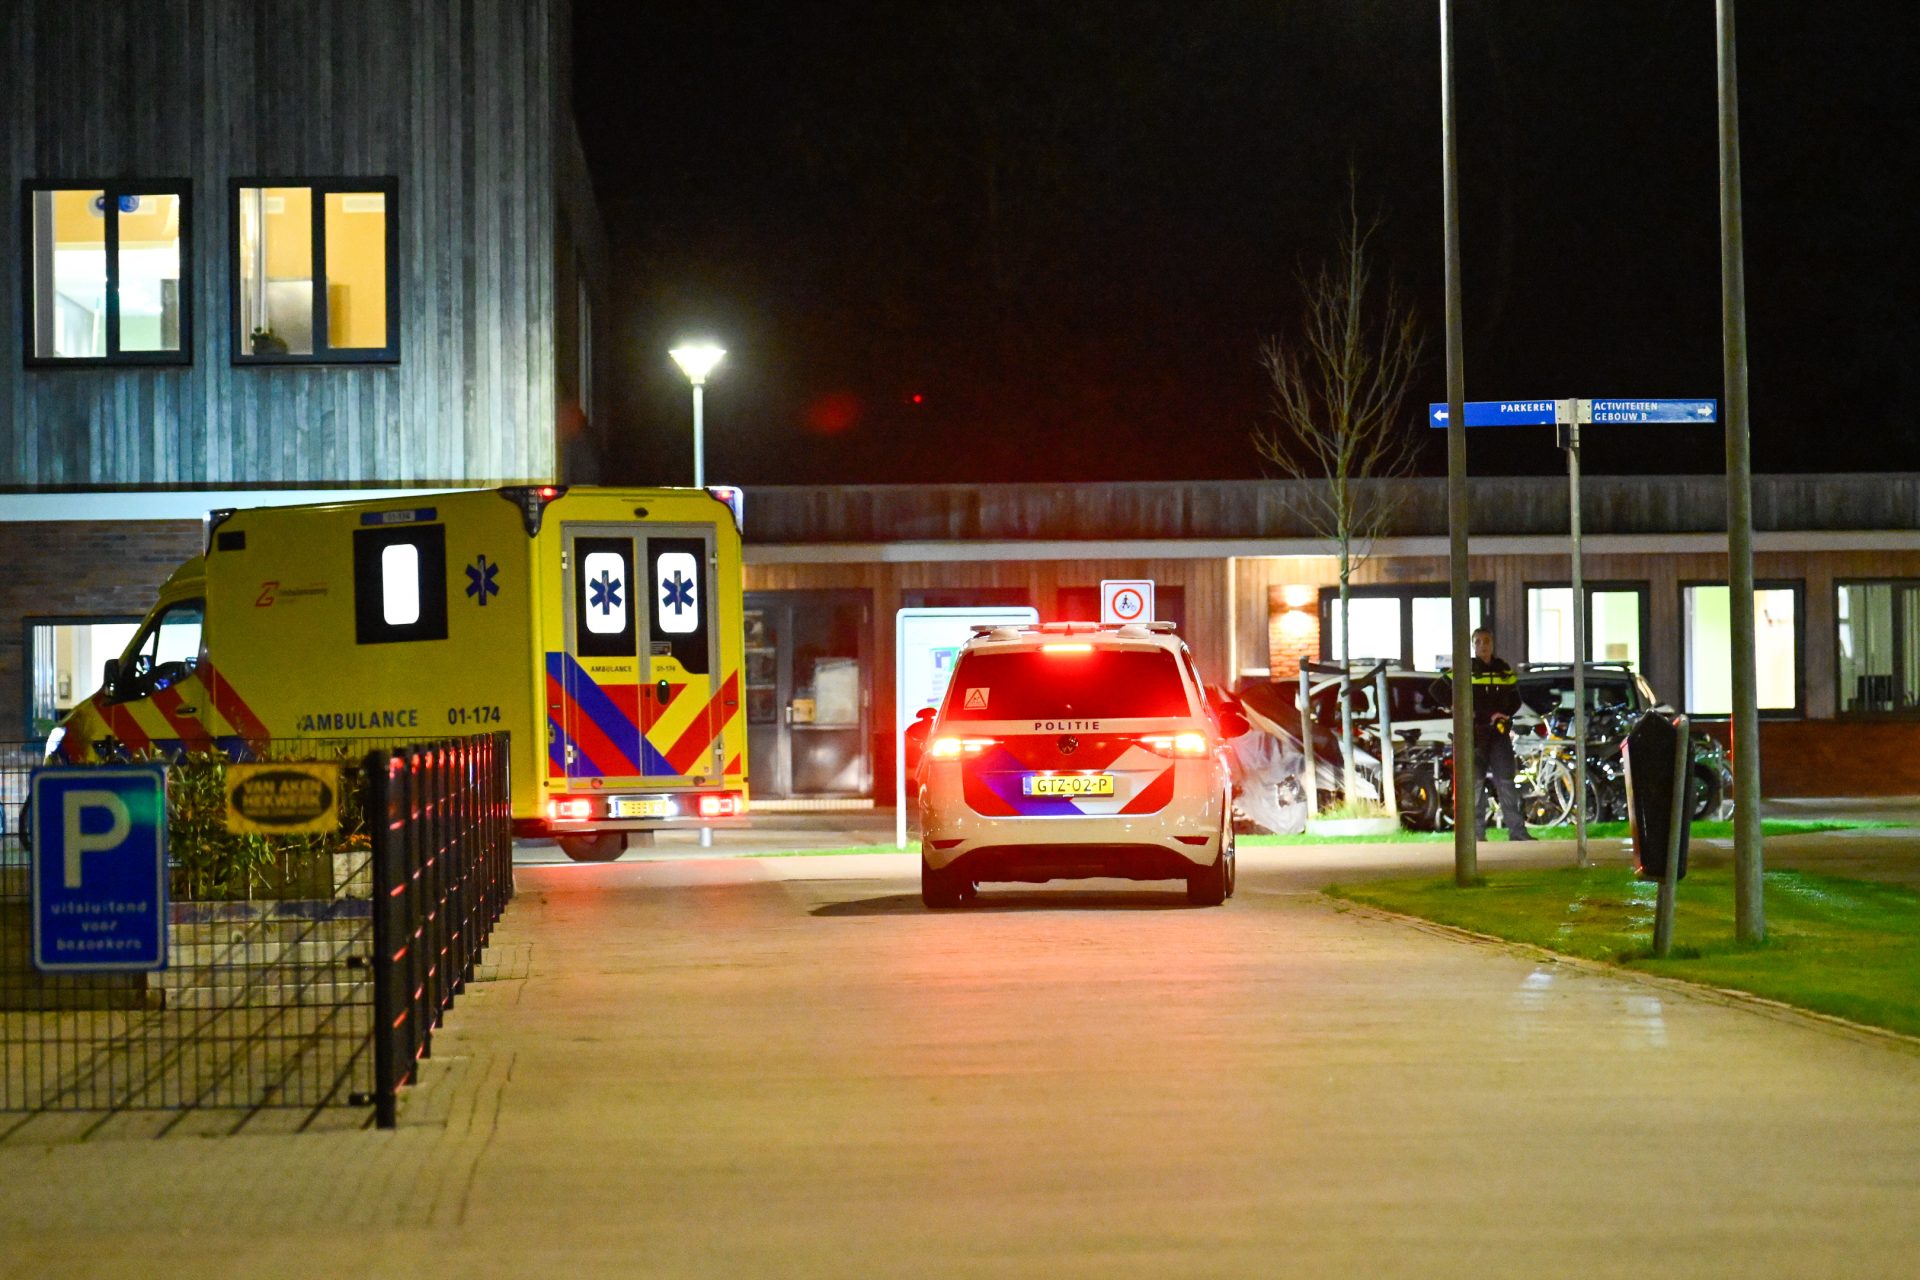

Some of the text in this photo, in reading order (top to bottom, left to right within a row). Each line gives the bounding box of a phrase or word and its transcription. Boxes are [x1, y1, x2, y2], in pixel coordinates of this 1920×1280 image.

[1501, 403, 1553, 412] PARKEREN
[1594, 402, 1658, 411] ACTIVITEITEN
[1594, 412, 1648, 421] GEBOUW B
[591, 665, 632, 673] AMBULANCE
[303, 706, 501, 731] AMBULANCE 01-174
[1034, 721, 1100, 731] POLITIE
[1037, 778, 1108, 793] GTZ-02-P
[63, 789, 132, 889] P
[82, 920, 118, 932] voor
